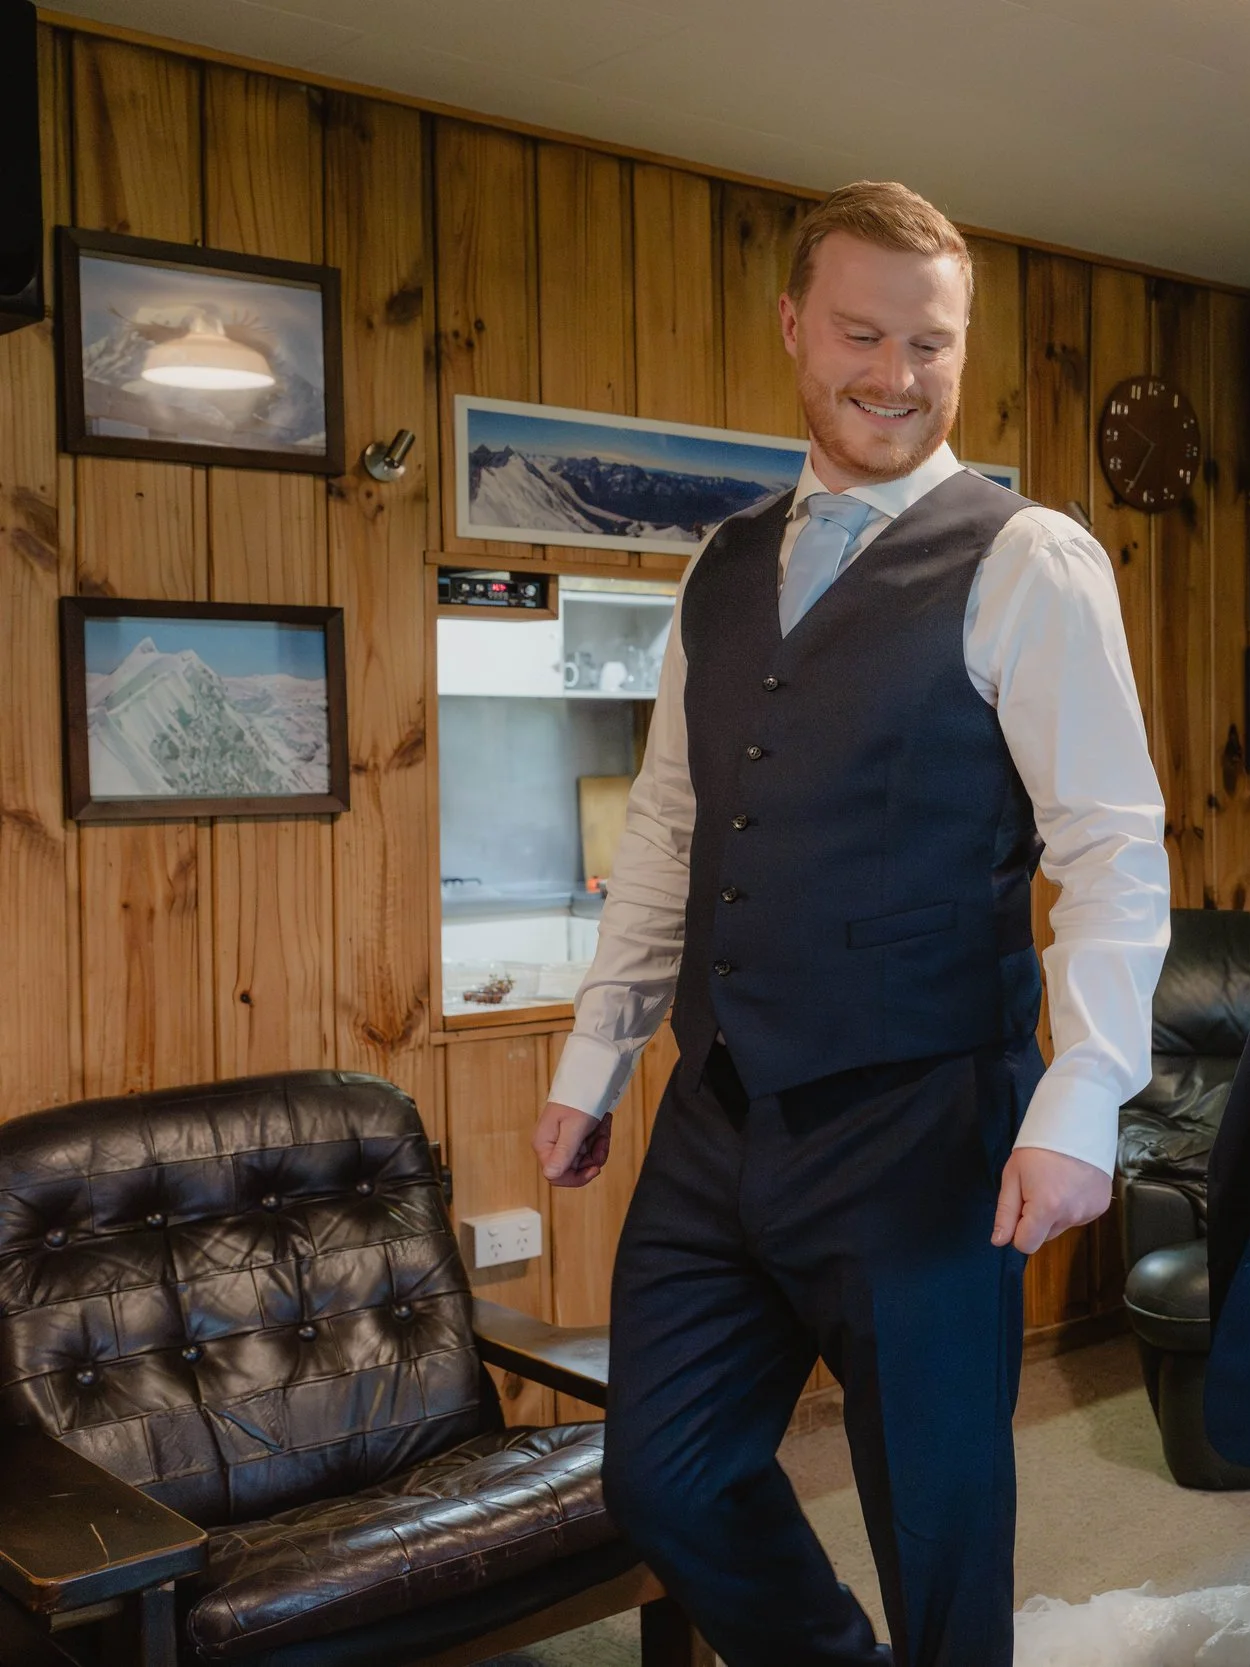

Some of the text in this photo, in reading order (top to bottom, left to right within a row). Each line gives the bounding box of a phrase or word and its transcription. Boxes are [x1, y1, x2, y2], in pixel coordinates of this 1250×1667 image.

[1131, 384, 1142, 400] 11
[1111, 400, 1129, 415] 10
[1109, 457, 1122, 470] 8
